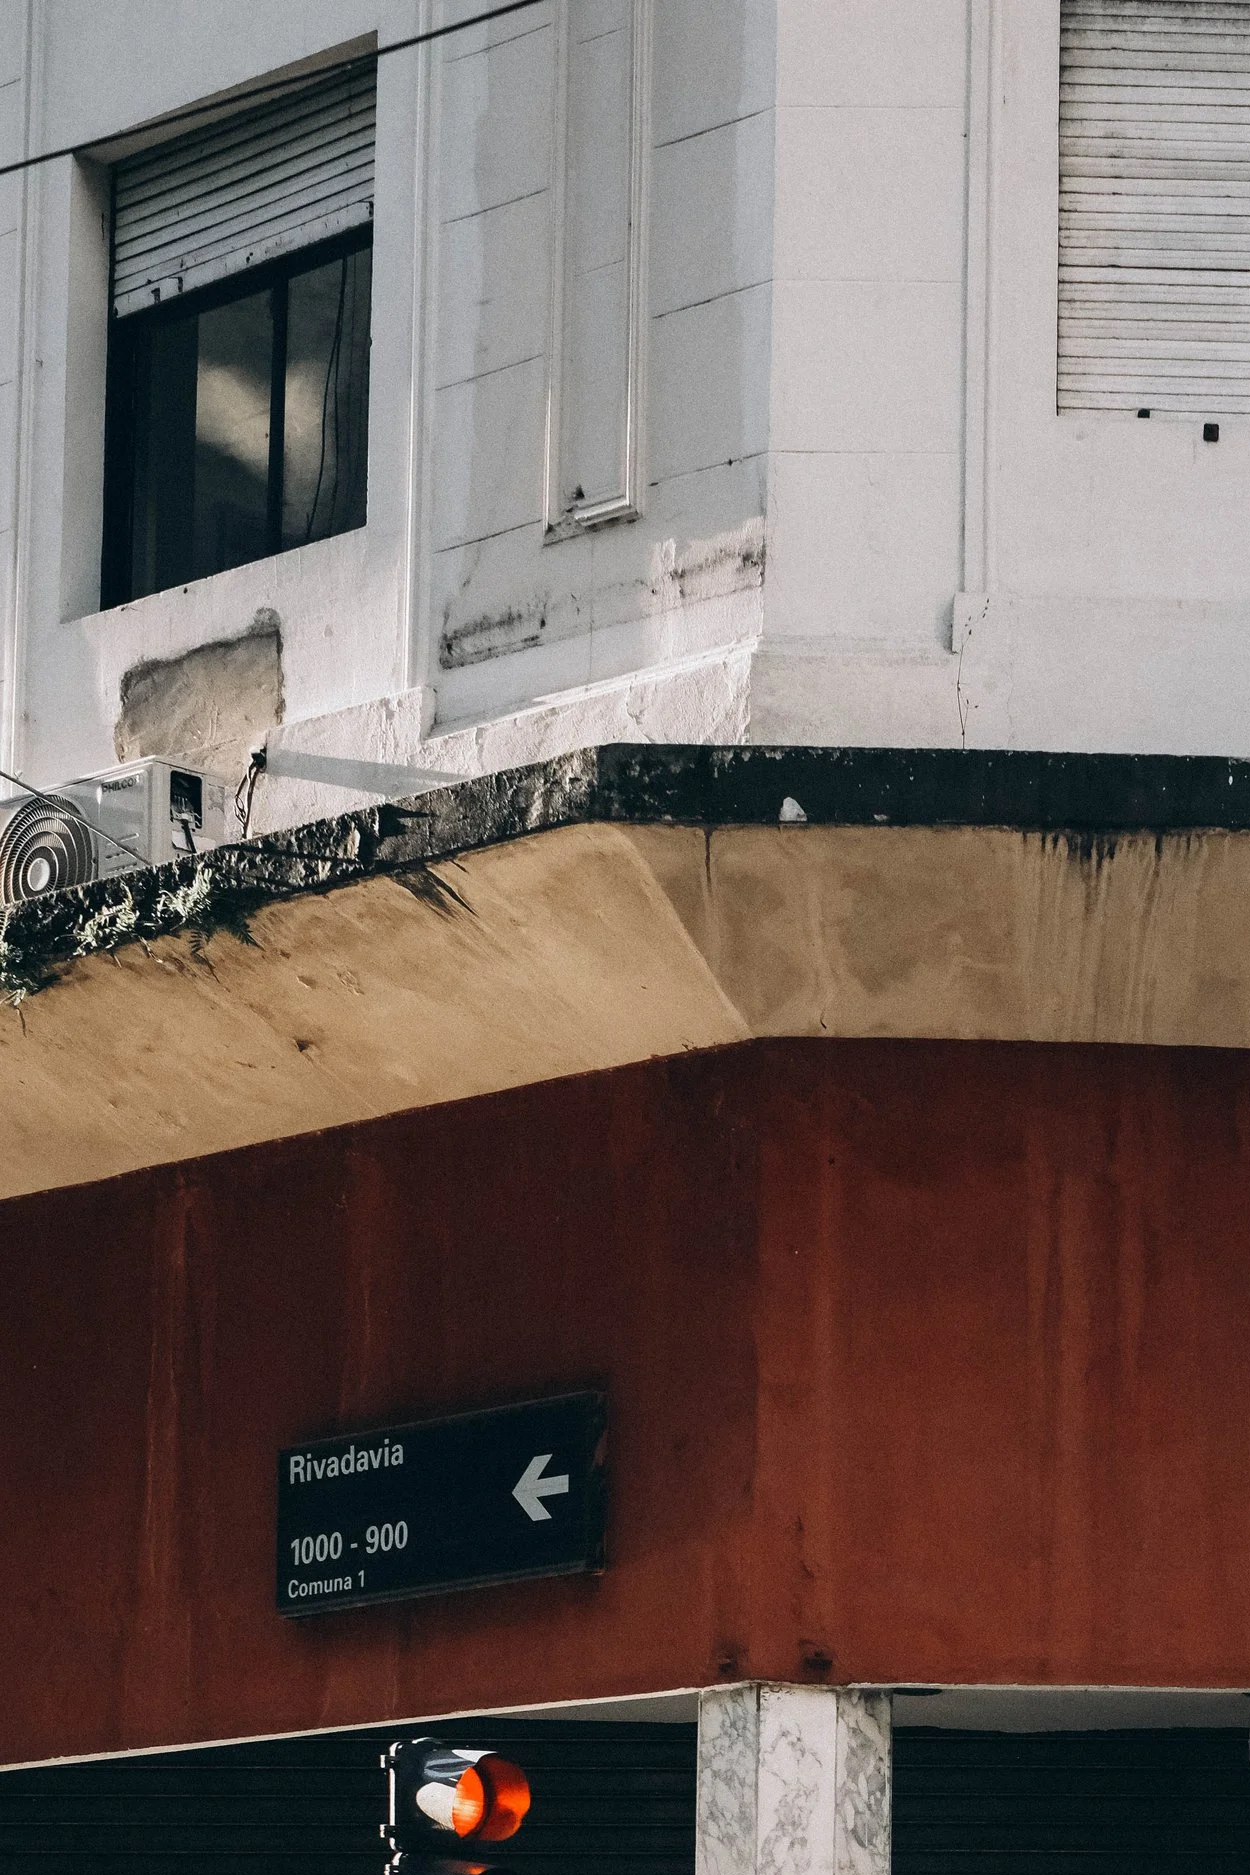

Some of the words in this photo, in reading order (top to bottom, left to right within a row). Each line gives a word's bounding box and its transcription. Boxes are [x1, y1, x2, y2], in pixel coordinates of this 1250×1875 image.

[289, 1438, 405, 1485] Rivadavia
[290, 1531, 343, 1566] 1000
[365, 1520, 409, 1554] 900
[287, 1575, 353, 1599] Comuna
[358, 1569, 366, 1588] 1
